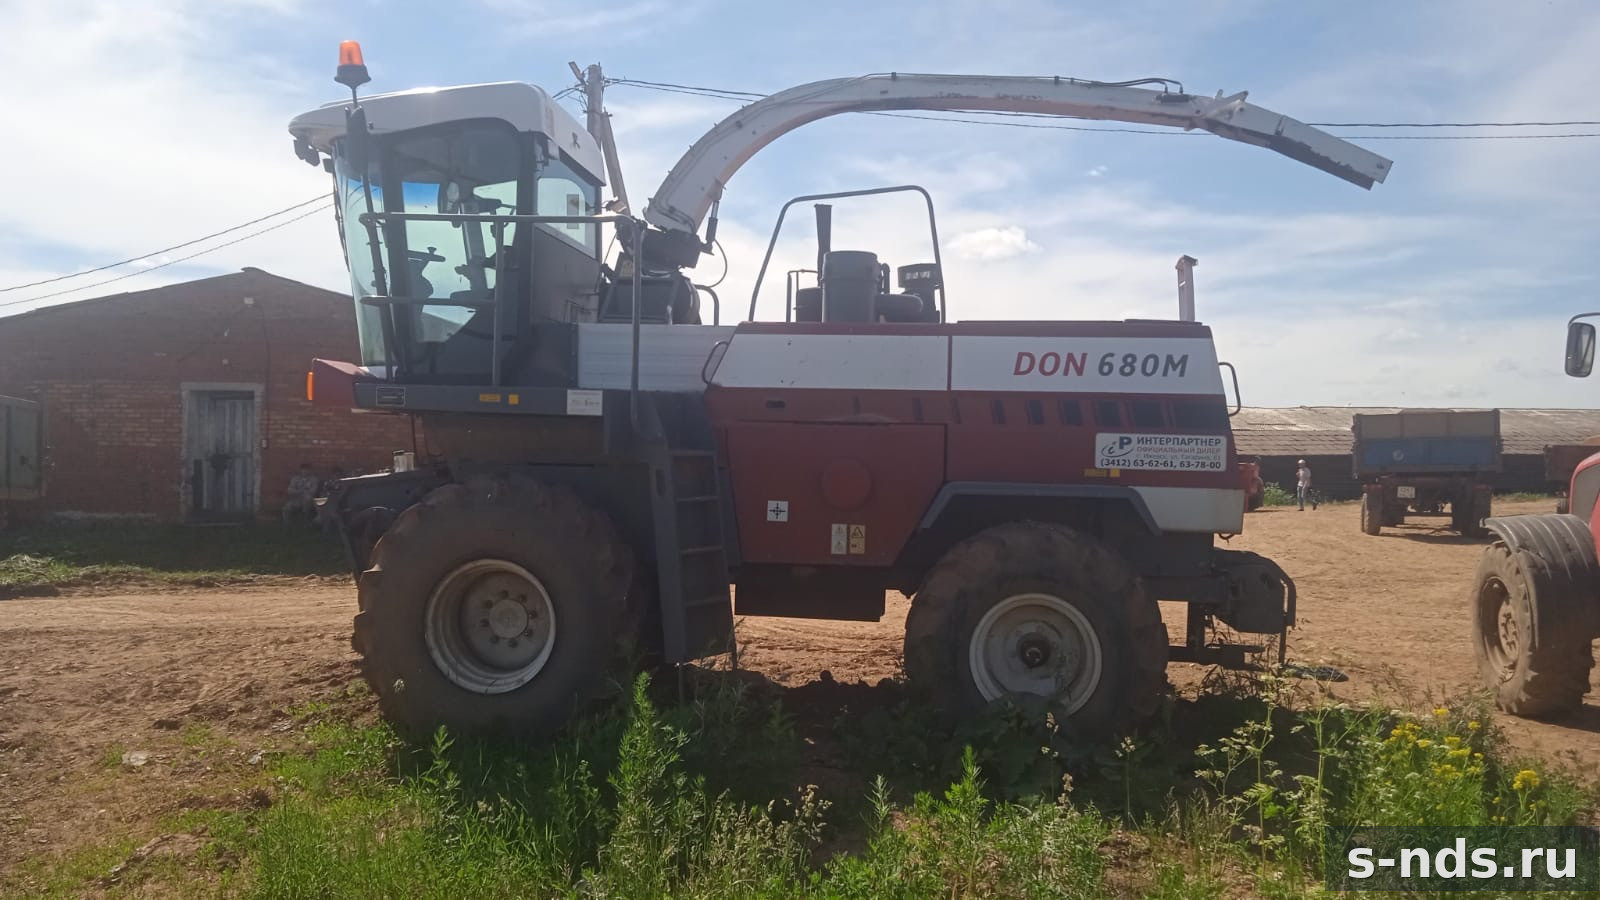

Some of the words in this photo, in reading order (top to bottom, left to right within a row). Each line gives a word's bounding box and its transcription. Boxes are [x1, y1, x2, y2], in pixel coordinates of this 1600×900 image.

[1013, 351, 1088, 377] DON
[1098, 352, 1189, 378] 680M
[1136, 436, 1221, 447] ИНТЕРПАРТНЕР
[1136, 446, 1195, 454] ОФИЦИАЛЬНЫЙ
[1196, 447, 1221, 455] ДИЛЕР
[1100, 458, 1131, 468] (3412)
[1133, 459, 1177, 469] 63-62-61,
[1179, 461, 1221, 469] 63-78-00
